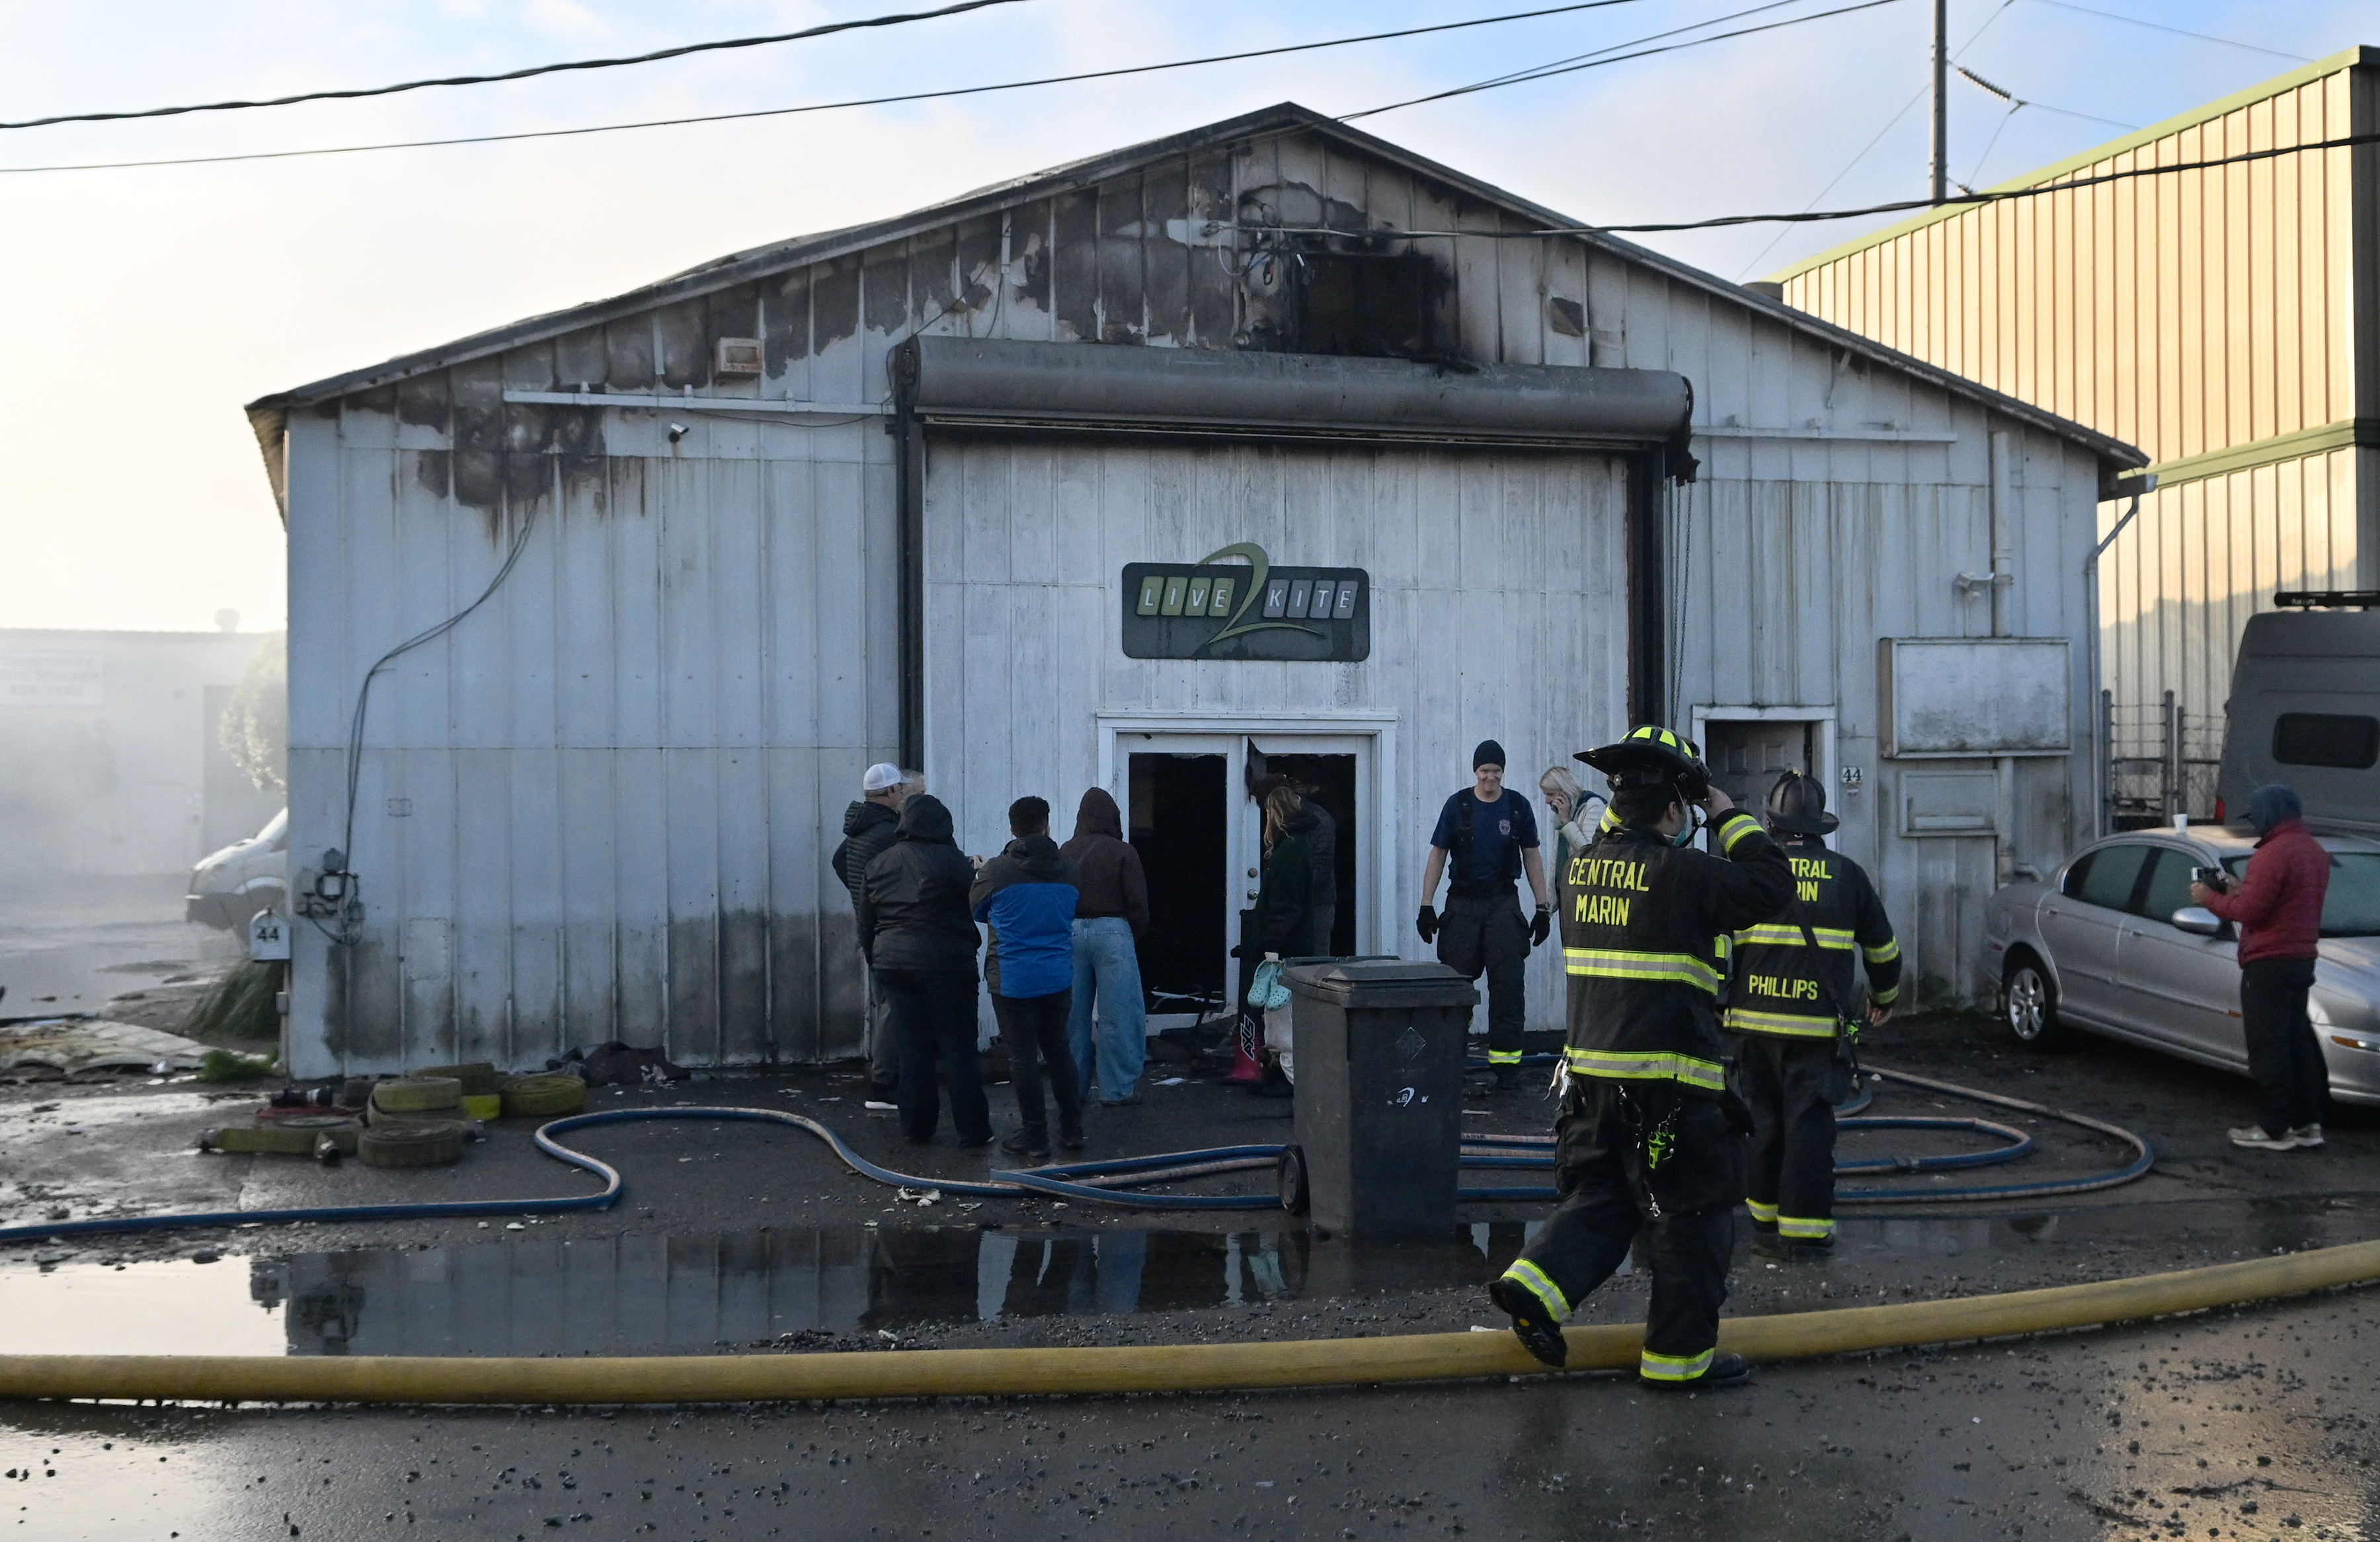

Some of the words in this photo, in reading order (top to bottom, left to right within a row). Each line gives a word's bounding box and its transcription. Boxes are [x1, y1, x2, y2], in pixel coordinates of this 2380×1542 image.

[1146, 588, 1227, 609] LIVE
[1191, 542, 1326, 645] 2
[1269, 588, 1352, 609] KITE
[1843, 767, 1862, 782] 44
[1568, 857, 1649, 892] CENTRAL
[1788, 858, 1833, 880] TRAL
[1575, 894, 1630, 927] MARIN
[257, 927, 279, 941] 44
[1749, 974, 1818, 1000] PHILLIPS
[1240, 1013, 1255, 1061] AXIS
